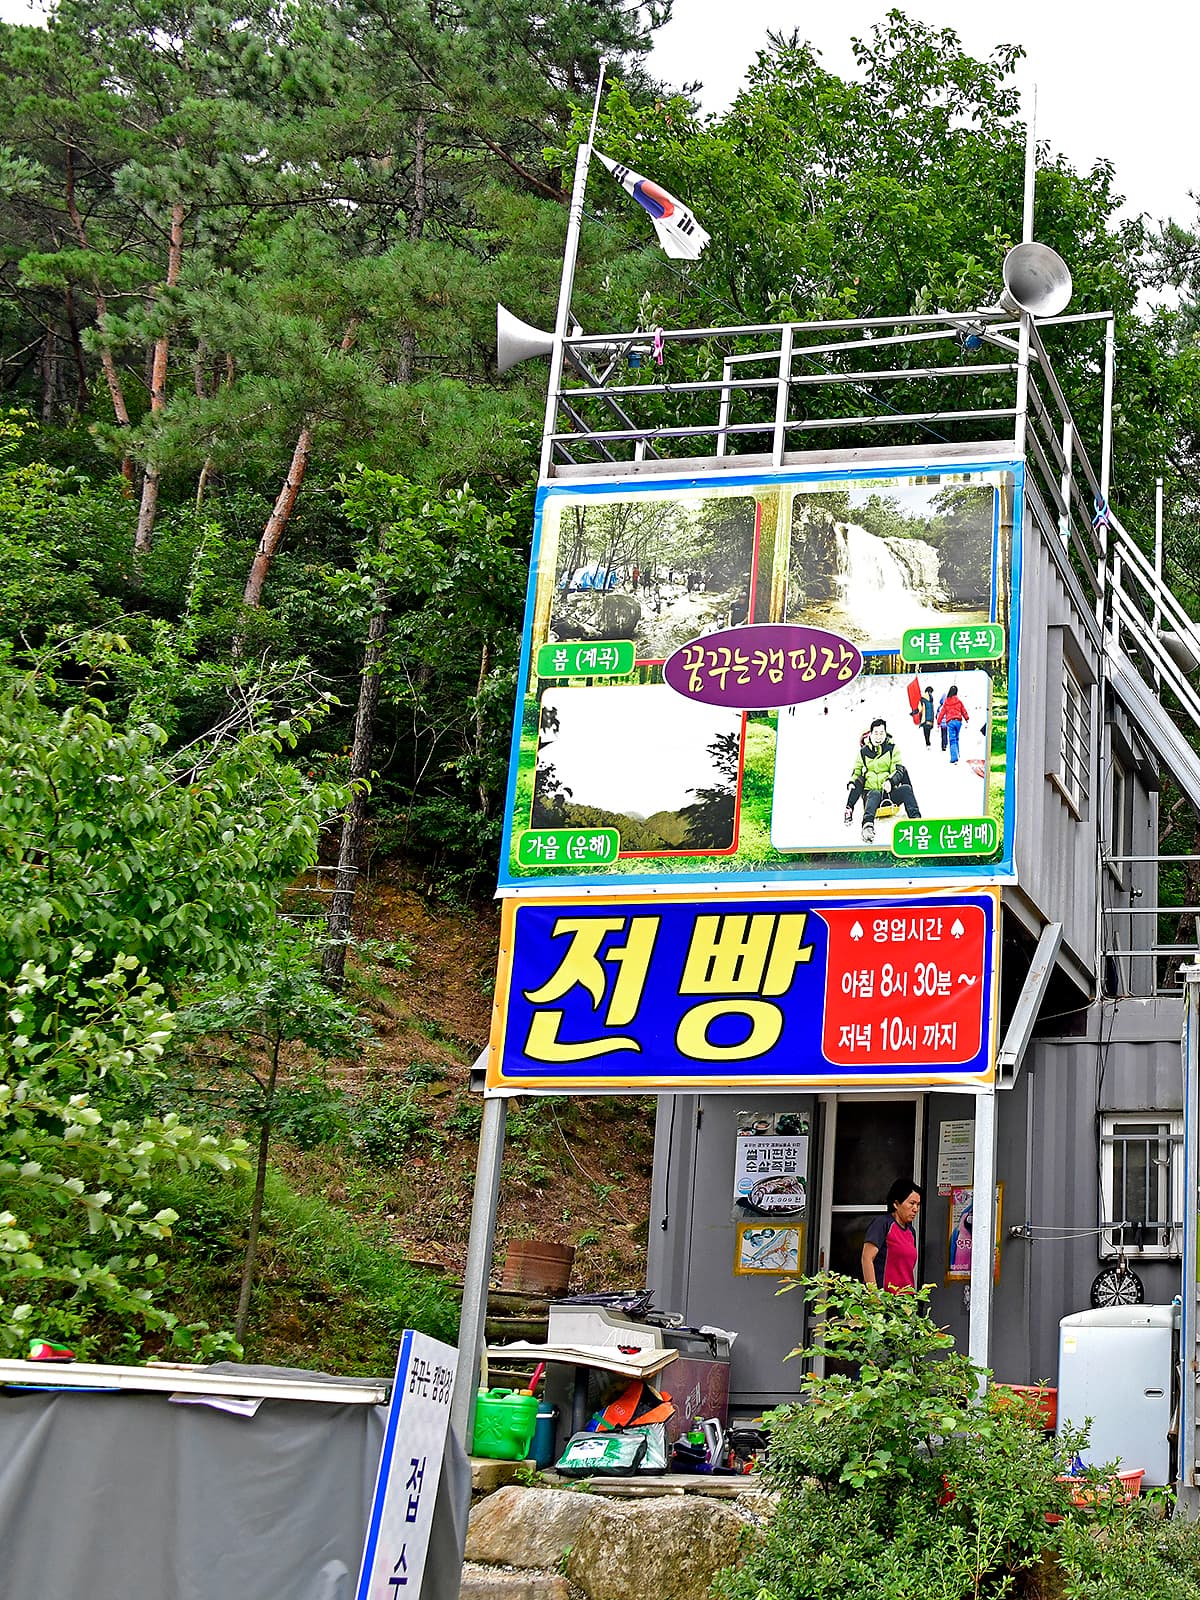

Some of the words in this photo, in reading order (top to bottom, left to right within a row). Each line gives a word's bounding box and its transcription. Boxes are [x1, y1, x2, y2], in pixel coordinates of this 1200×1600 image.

[910, 632, 943, 656] 여름
[950, 630, 996, 655] (폭포)
[552, 648, 569, 672] 봄
[575, 646, 619, 671] (계곡)
[526, 835, 560, 860] 가을
[566, 834, 611, 859] (운해)
[898, 825, 933, 850] 겨울
[939, 823, 994, 849] (눈썰매)
[873, 917, 944, 943] 영업시간
[841, 969, 875, 999] 아침
[880, 962, 908, 998] 8시
[838, 1023, 873, 1052] 저녁
[880, 1016, 917, 1051] 10시
[922, 1021, 957, 1051] 까지
